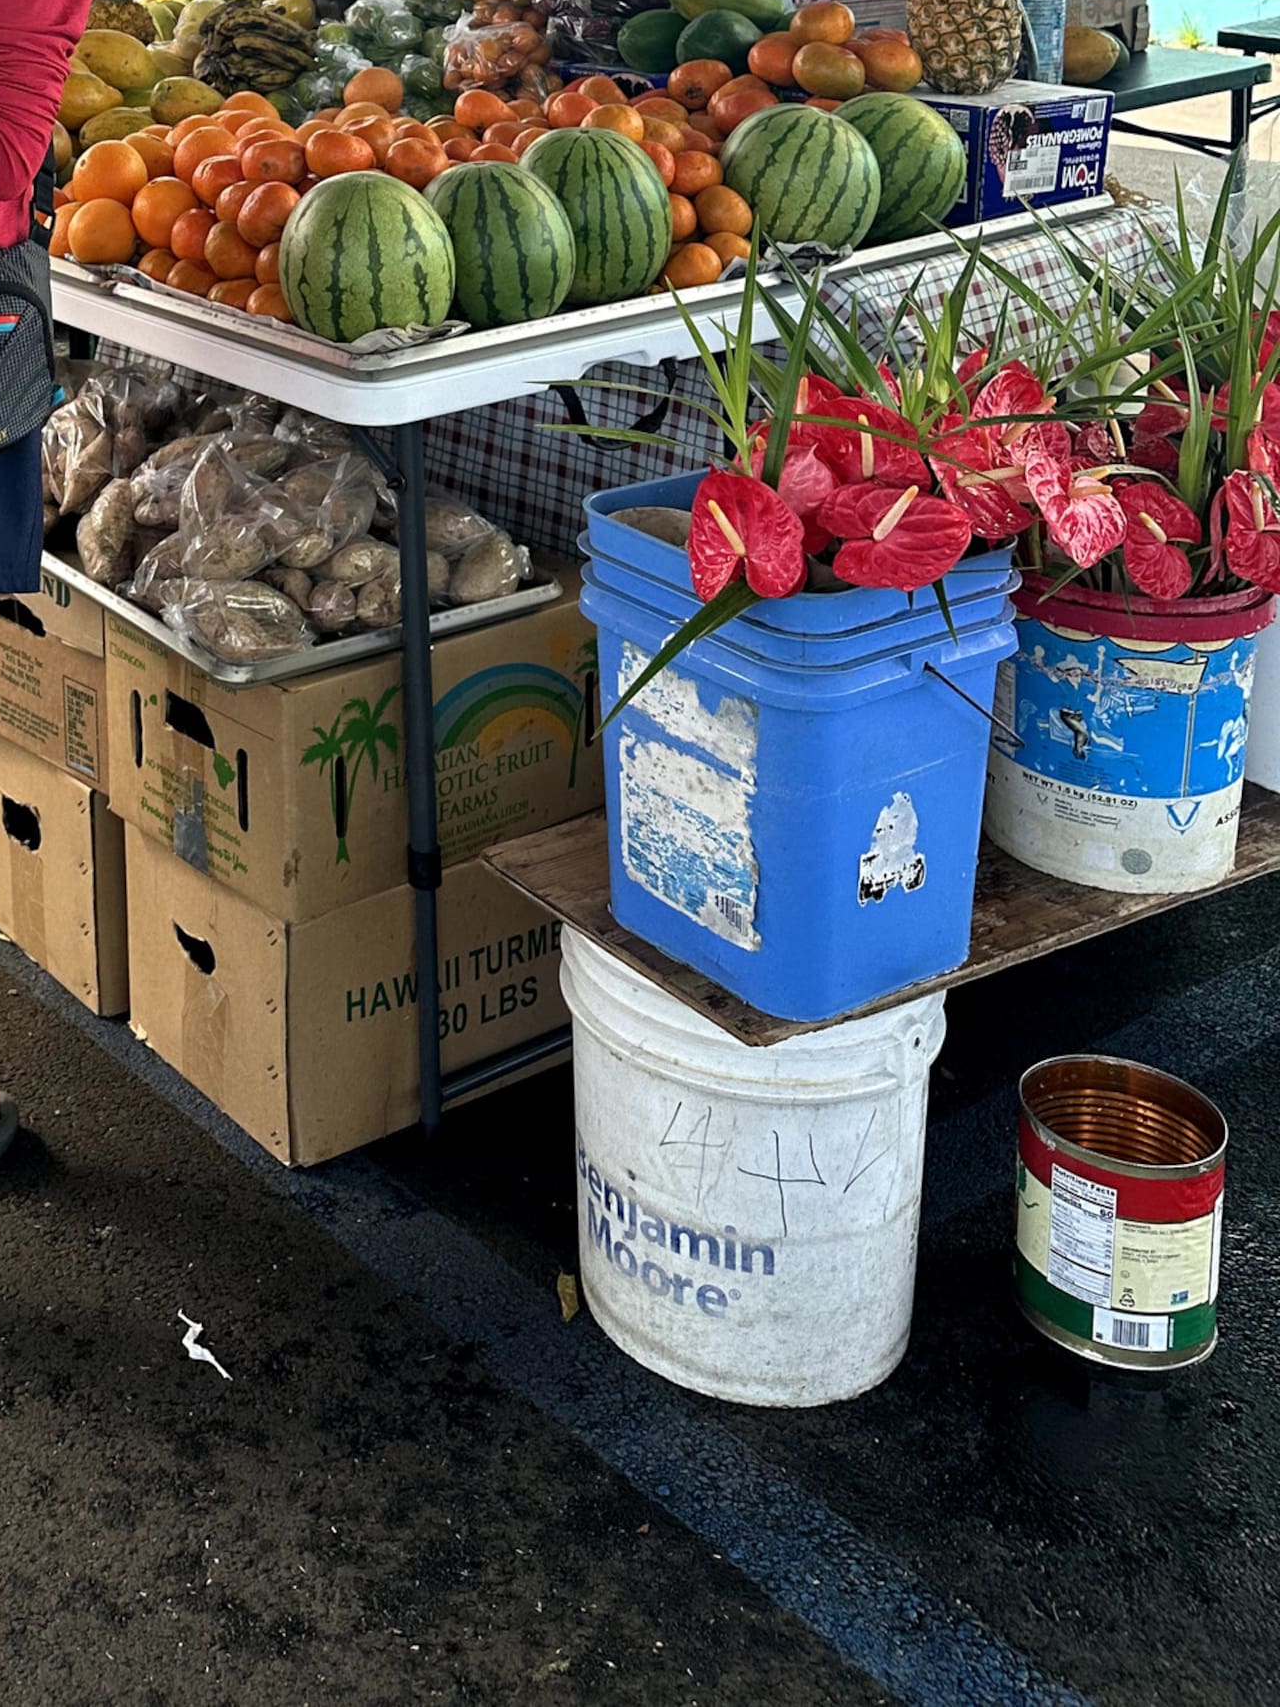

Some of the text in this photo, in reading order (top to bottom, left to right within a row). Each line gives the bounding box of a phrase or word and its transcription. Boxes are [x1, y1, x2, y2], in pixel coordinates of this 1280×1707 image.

[1025, 124, 1104, 149] POMEGRANATES
[437, 739, 555, 797] OTIC FRUIT
[1022, 770, 1039, 784] NET
[1040, 778, 1054, 790] WT
[437, 785, 499, 824] FARMS
[345, 919, 565, 1023] HAWII TURME
[480, 975, 539, 1025] LBS
[1053, 1165, 1116, 1197] Nutrition Facts
[577, 1146, 776, 1276] Benjamin
